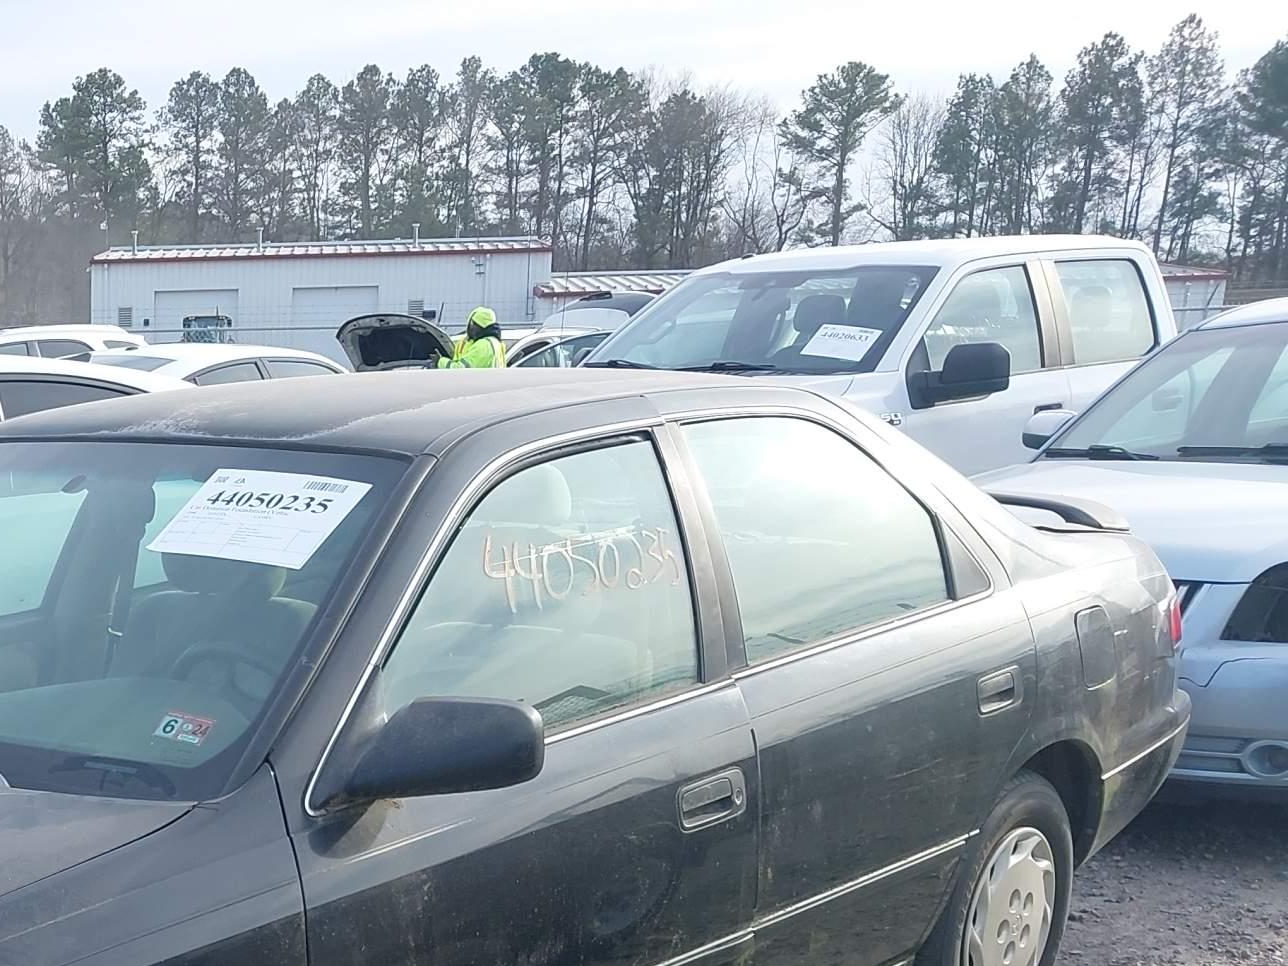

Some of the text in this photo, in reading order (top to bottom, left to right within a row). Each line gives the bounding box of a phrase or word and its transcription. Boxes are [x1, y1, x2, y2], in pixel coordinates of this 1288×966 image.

[206, 489, 334, 515] 44050235
[482, 526, 680, 614] 44050235
[162, 718, 179, 734] 6
